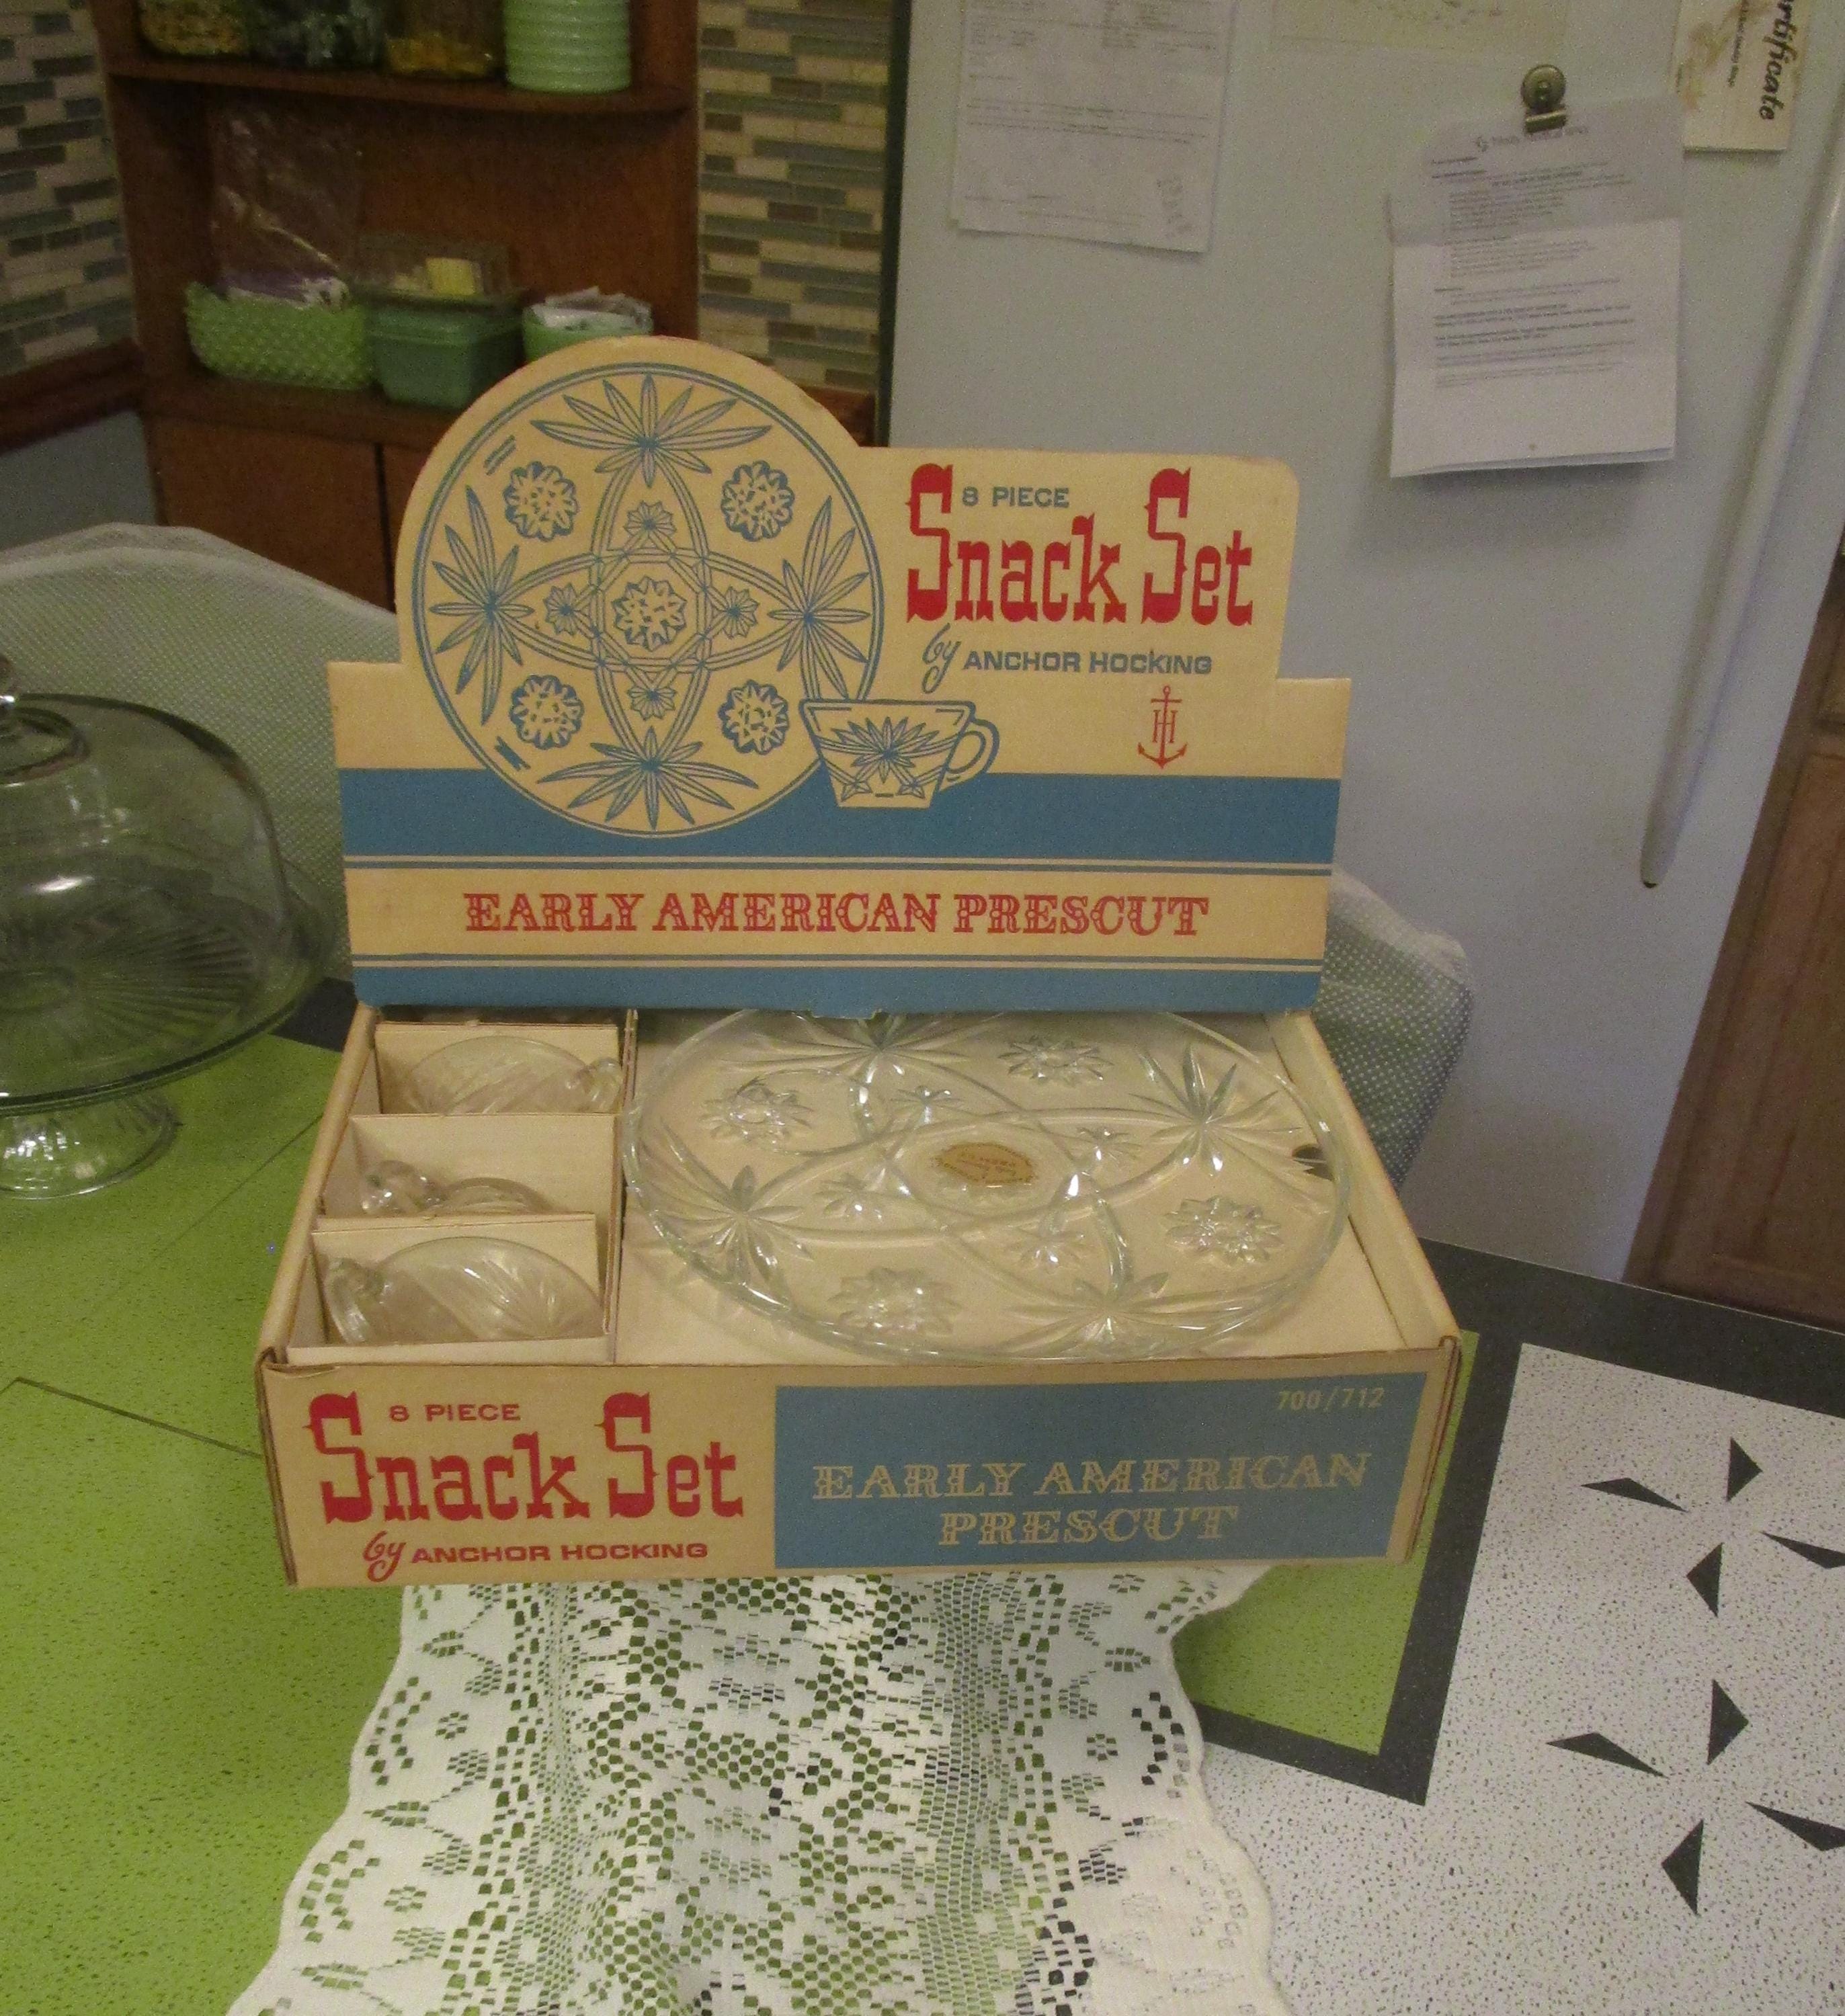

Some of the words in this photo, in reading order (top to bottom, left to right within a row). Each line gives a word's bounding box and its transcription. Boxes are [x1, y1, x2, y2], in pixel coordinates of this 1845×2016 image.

[1759, 0, 1797, 120] rtificate
[962, 486, 979, 507] 8
[992, 487, 1070, 508] PIECE
[905, 462, 1127, 623] Snack
[1141, 466, 1254, 626] Set
[921, 623, 961, 694] by
[963, 650, 1079, 672] ANCHOR
[1088, 650, 1213, 675] HOCKING
[462, 892, 645, 932] EARLY
[652, 892, 942, 933] AMERICAN
[952, 894, 1209, 936] PRESCUT
[388, 1404, 410, 1422] 8
[424, 1403, 521, 1422] PIECE
[1278, 1387, 1385, 1412] 700/712
[302, 1390, 591, 1524] Snack
[594, 1391, 744, 1519] Set
[812, 1462, 1026, 1501] EARLY
[1034, 1452, 1372, 1497] AMERICAN
[938, 1505, 1239, 1546] PRESCUT
[363, 1531, 407, 1583] by
[411, 1545, 550, 1564] ANCHOR
[561, 1542, 709, 1560] HOCKING
